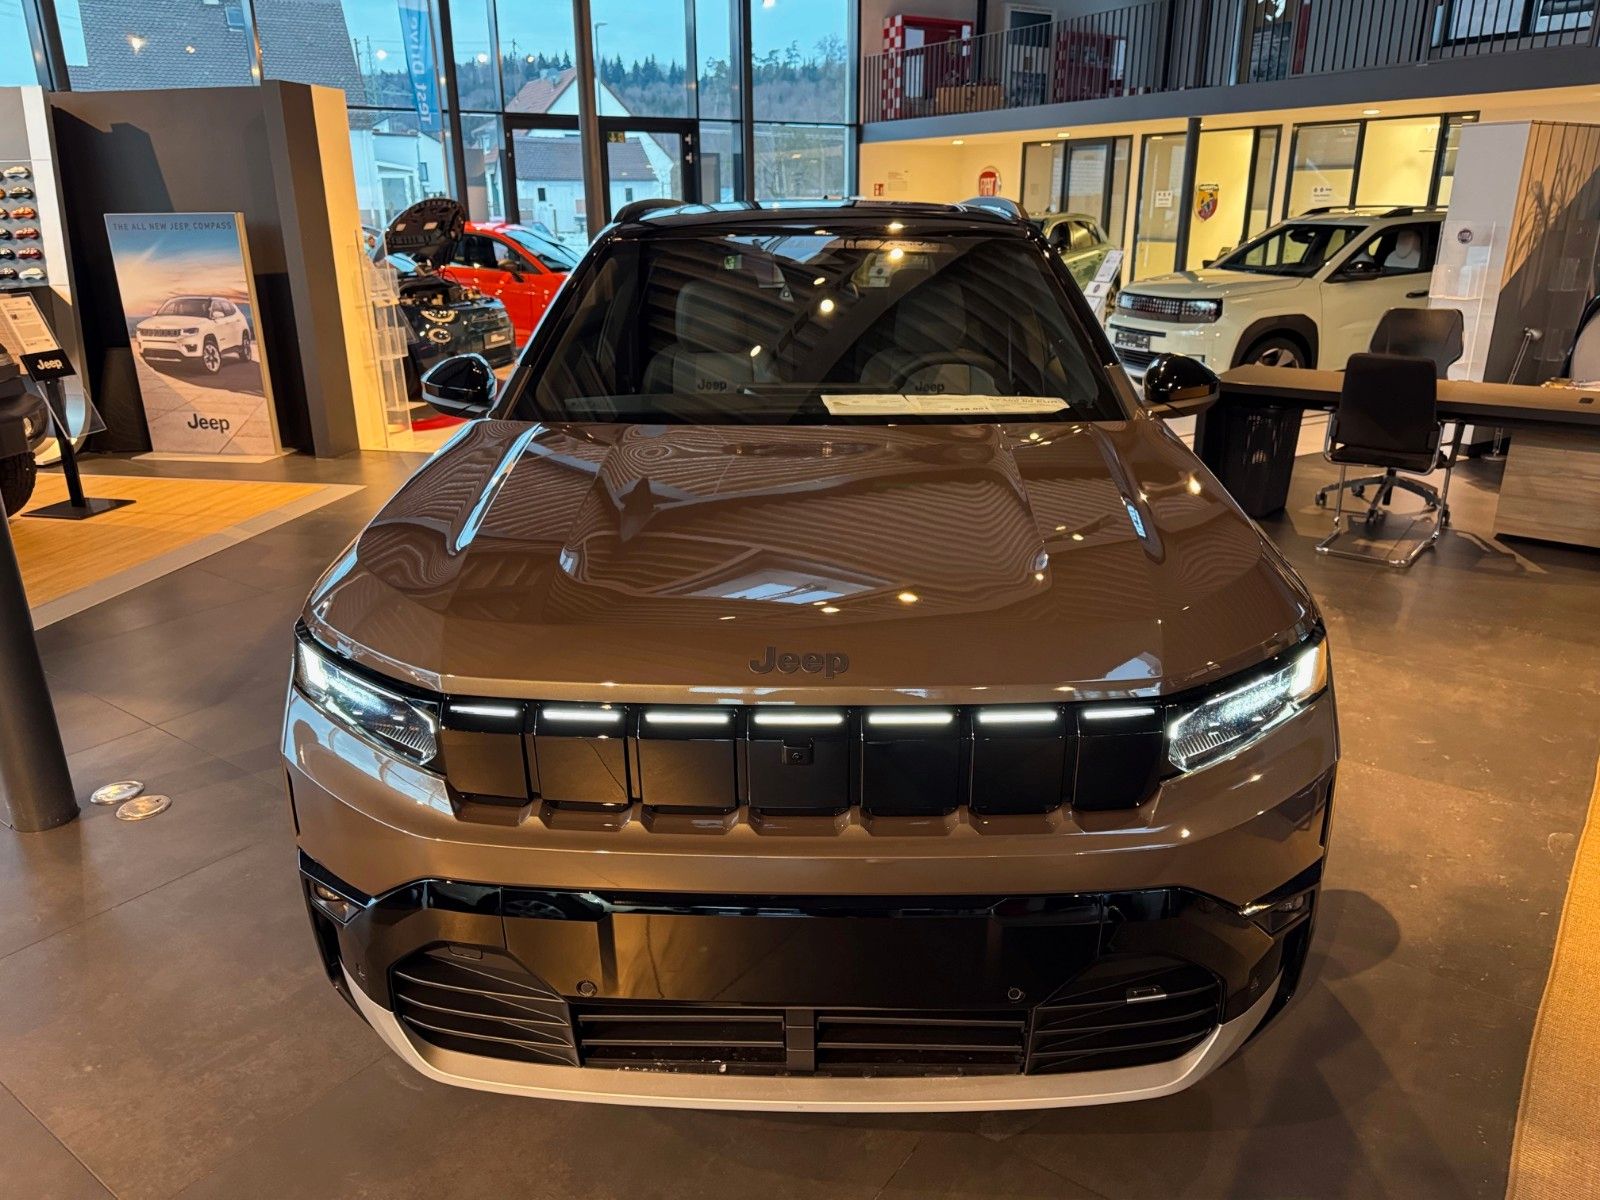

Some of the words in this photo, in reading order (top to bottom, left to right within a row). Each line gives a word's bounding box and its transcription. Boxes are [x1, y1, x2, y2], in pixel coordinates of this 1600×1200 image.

[113, 223, 129, 231] THE
[131, 223, 147, 231] ALL
[149, 223, 167, 231] NEW
[170, 222, 189, 230] JEEP
[192, 221, 232, 230] COMPASS
[36, 359, 63, 370] Jeep
[697, 379, 727, 391] Jeep
[915, 381, 945, 392] Jeep
[187, 413, 230, 434] Jeep
[748, 646, 849, 679] Jeep
